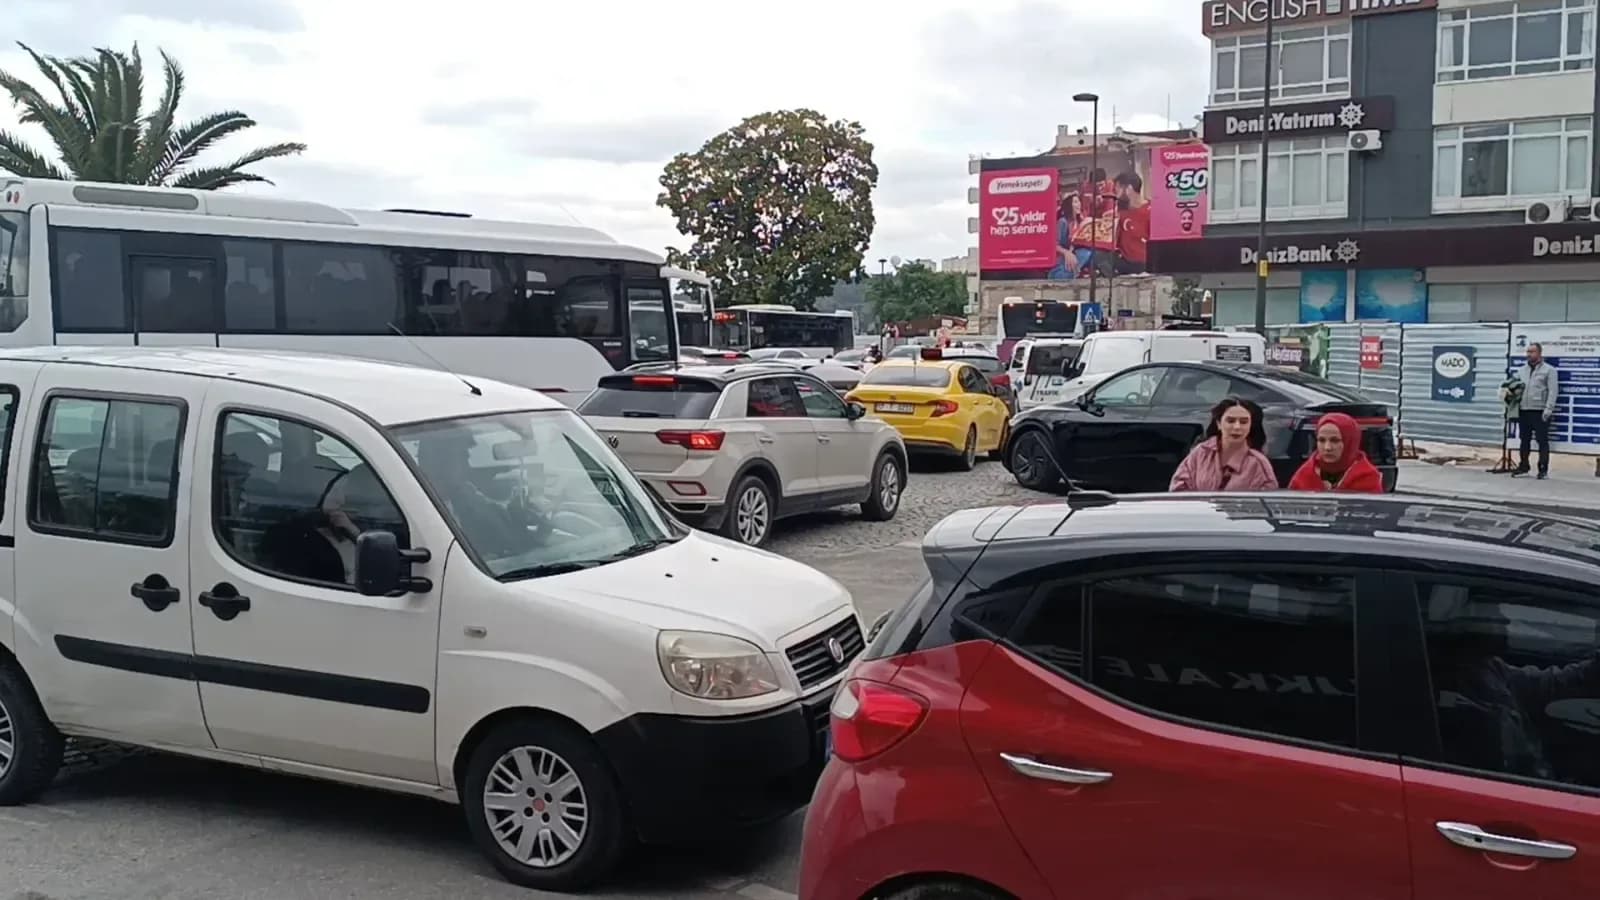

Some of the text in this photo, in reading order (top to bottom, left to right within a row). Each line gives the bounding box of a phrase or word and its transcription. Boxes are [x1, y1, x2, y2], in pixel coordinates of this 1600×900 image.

[1211, 0, 1320, 26] ENGLISH
[1167, 169, 1208, 188] %50
[990, 223, 1048, 237] hep seninle
[1441, 357, 1466, 368] MADO
